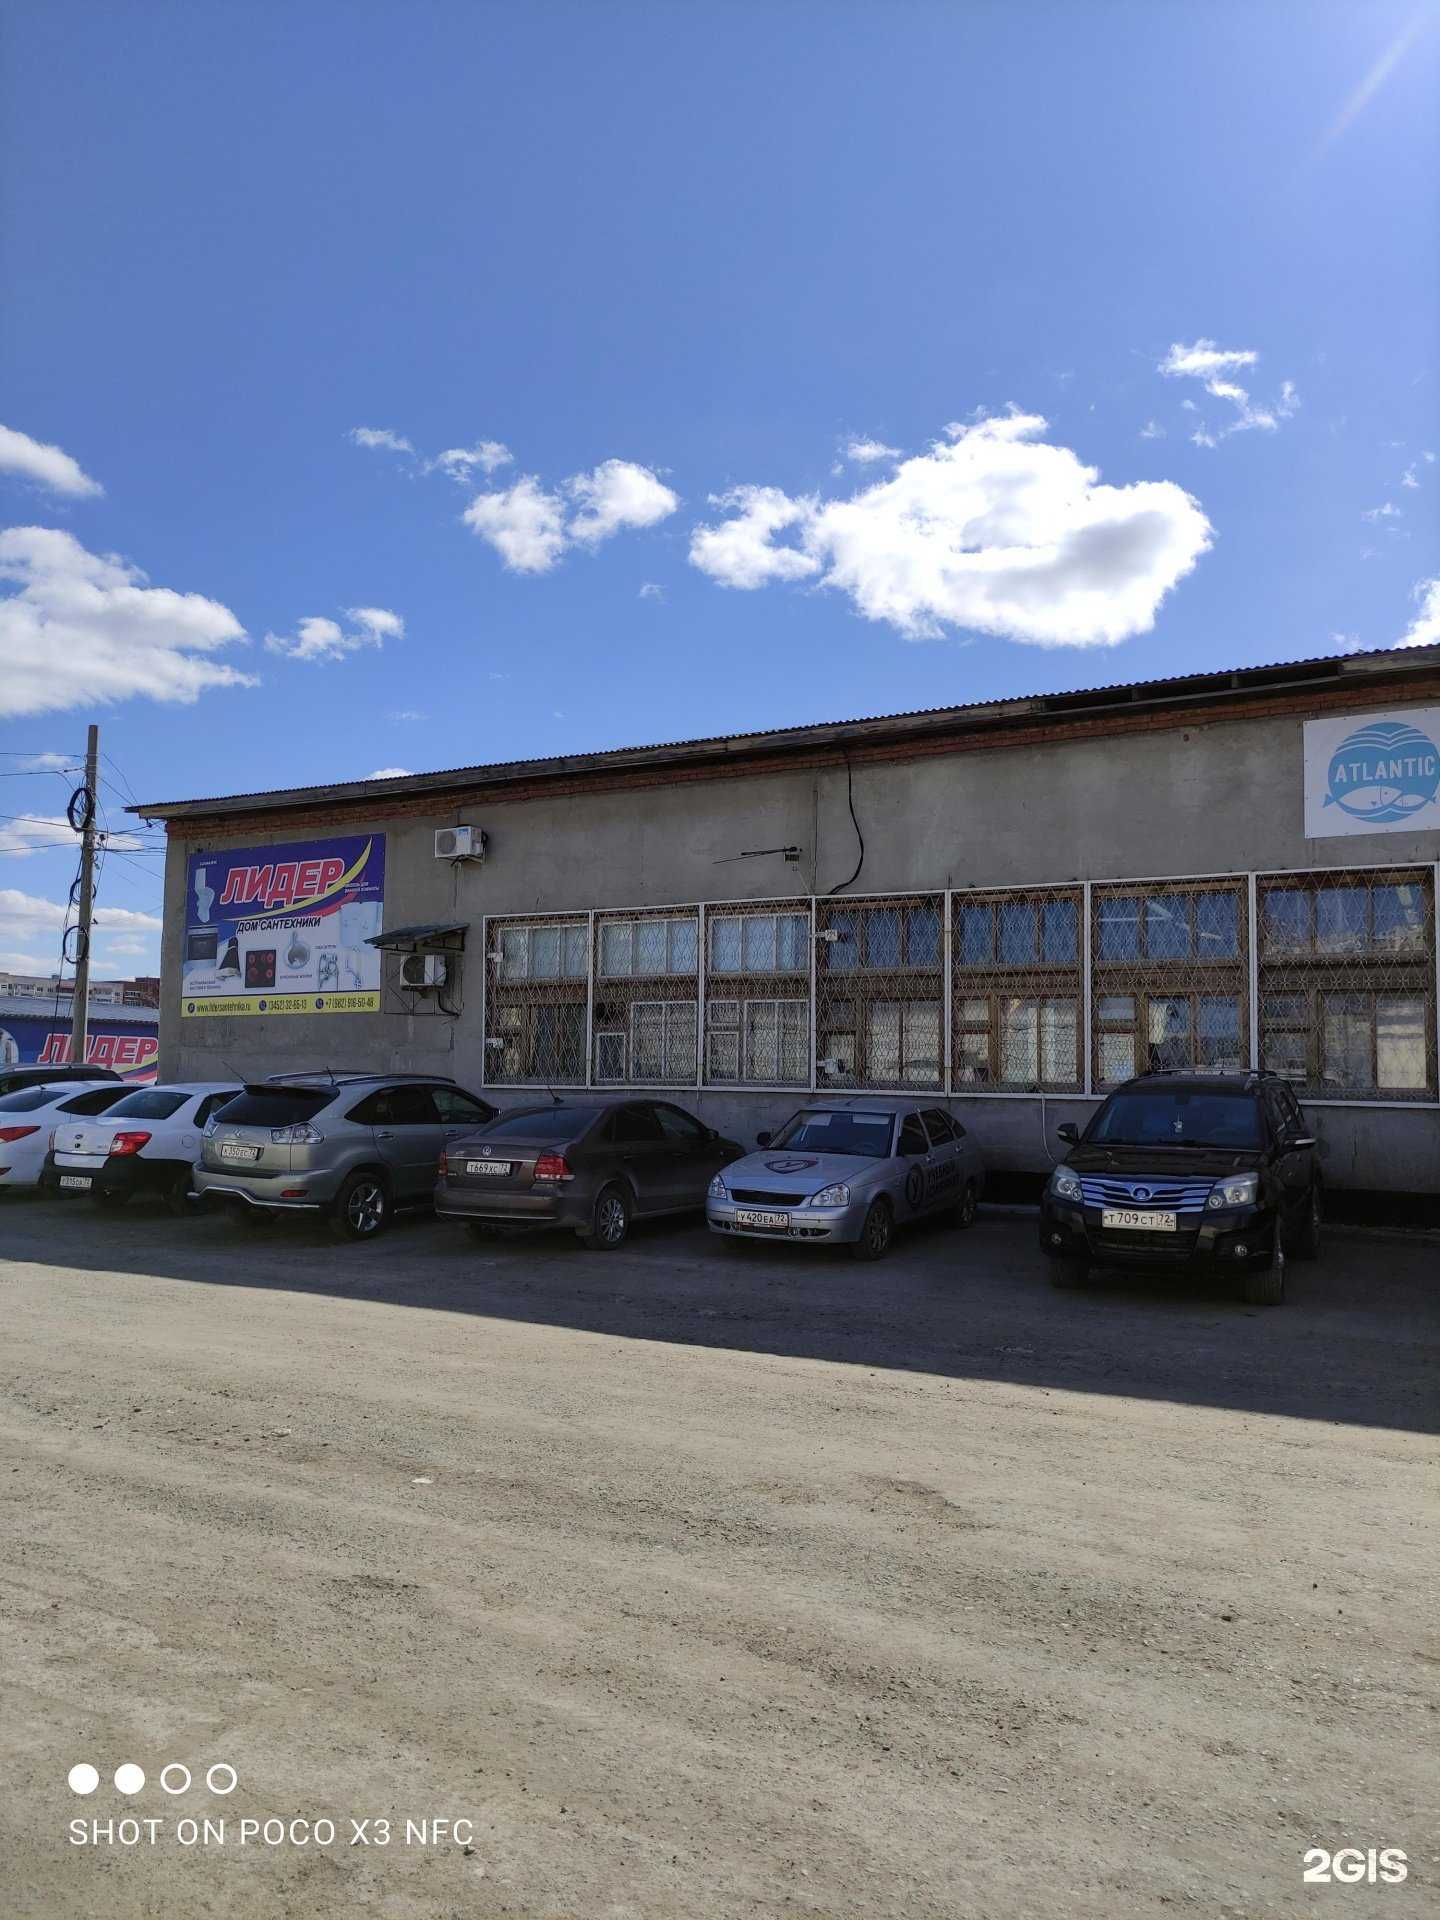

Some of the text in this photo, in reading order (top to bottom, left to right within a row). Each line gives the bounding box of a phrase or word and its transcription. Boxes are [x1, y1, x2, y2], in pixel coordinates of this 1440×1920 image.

[1335, 755, 1435, 783] ATLANTIC
[220, 857, 345, 909] ЛИДЕР
[237, 917, 321, 934] ДОМ САНТЕХНИКИ
[740, 1212, 785, 1224] У420ЕА 72
[1109, 1213, 1170, 1225] Т709СТ 72
